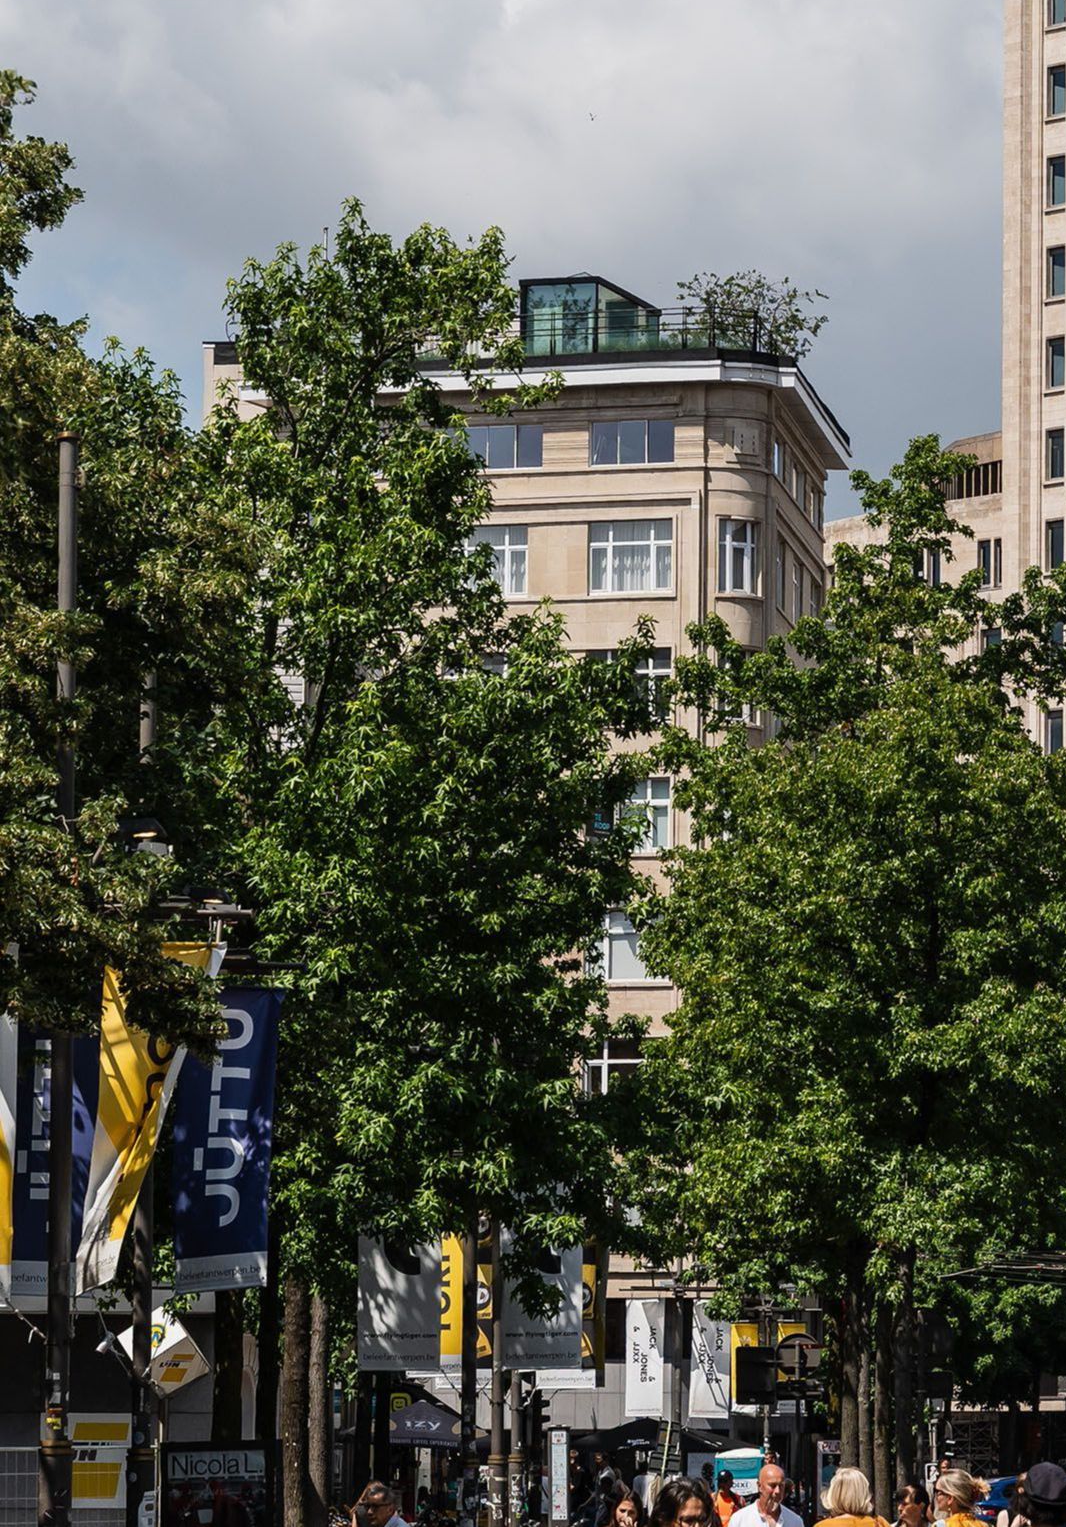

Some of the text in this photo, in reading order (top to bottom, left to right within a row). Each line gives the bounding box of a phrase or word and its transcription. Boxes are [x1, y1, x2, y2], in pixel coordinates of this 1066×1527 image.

[649, 1326, 657, 1349] JACK
[715, 1327, 723, 1351] JACK
[640, 1352, 648, 1383] JONES
[706, 1353, 715, 1384] JONES
[171, 1453, 264, 1475] Nicola L.
